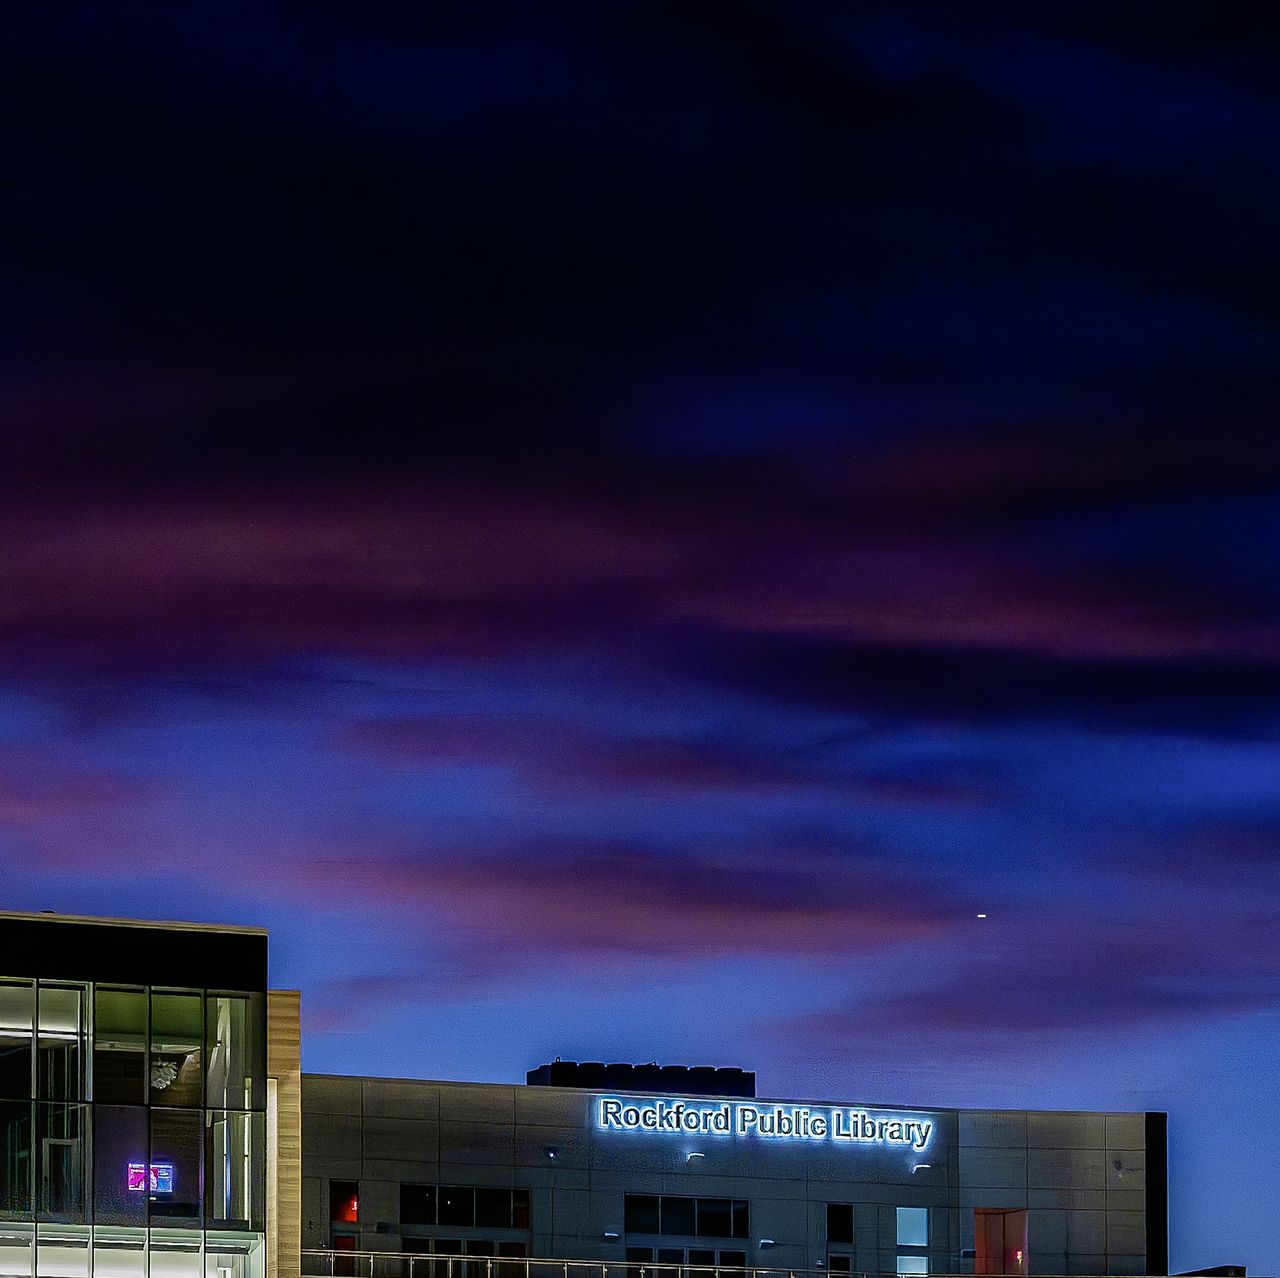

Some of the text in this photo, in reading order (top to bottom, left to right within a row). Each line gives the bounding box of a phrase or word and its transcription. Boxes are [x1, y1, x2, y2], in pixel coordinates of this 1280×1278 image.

[601, 1099, 933, 1149] Rockford Public Library
